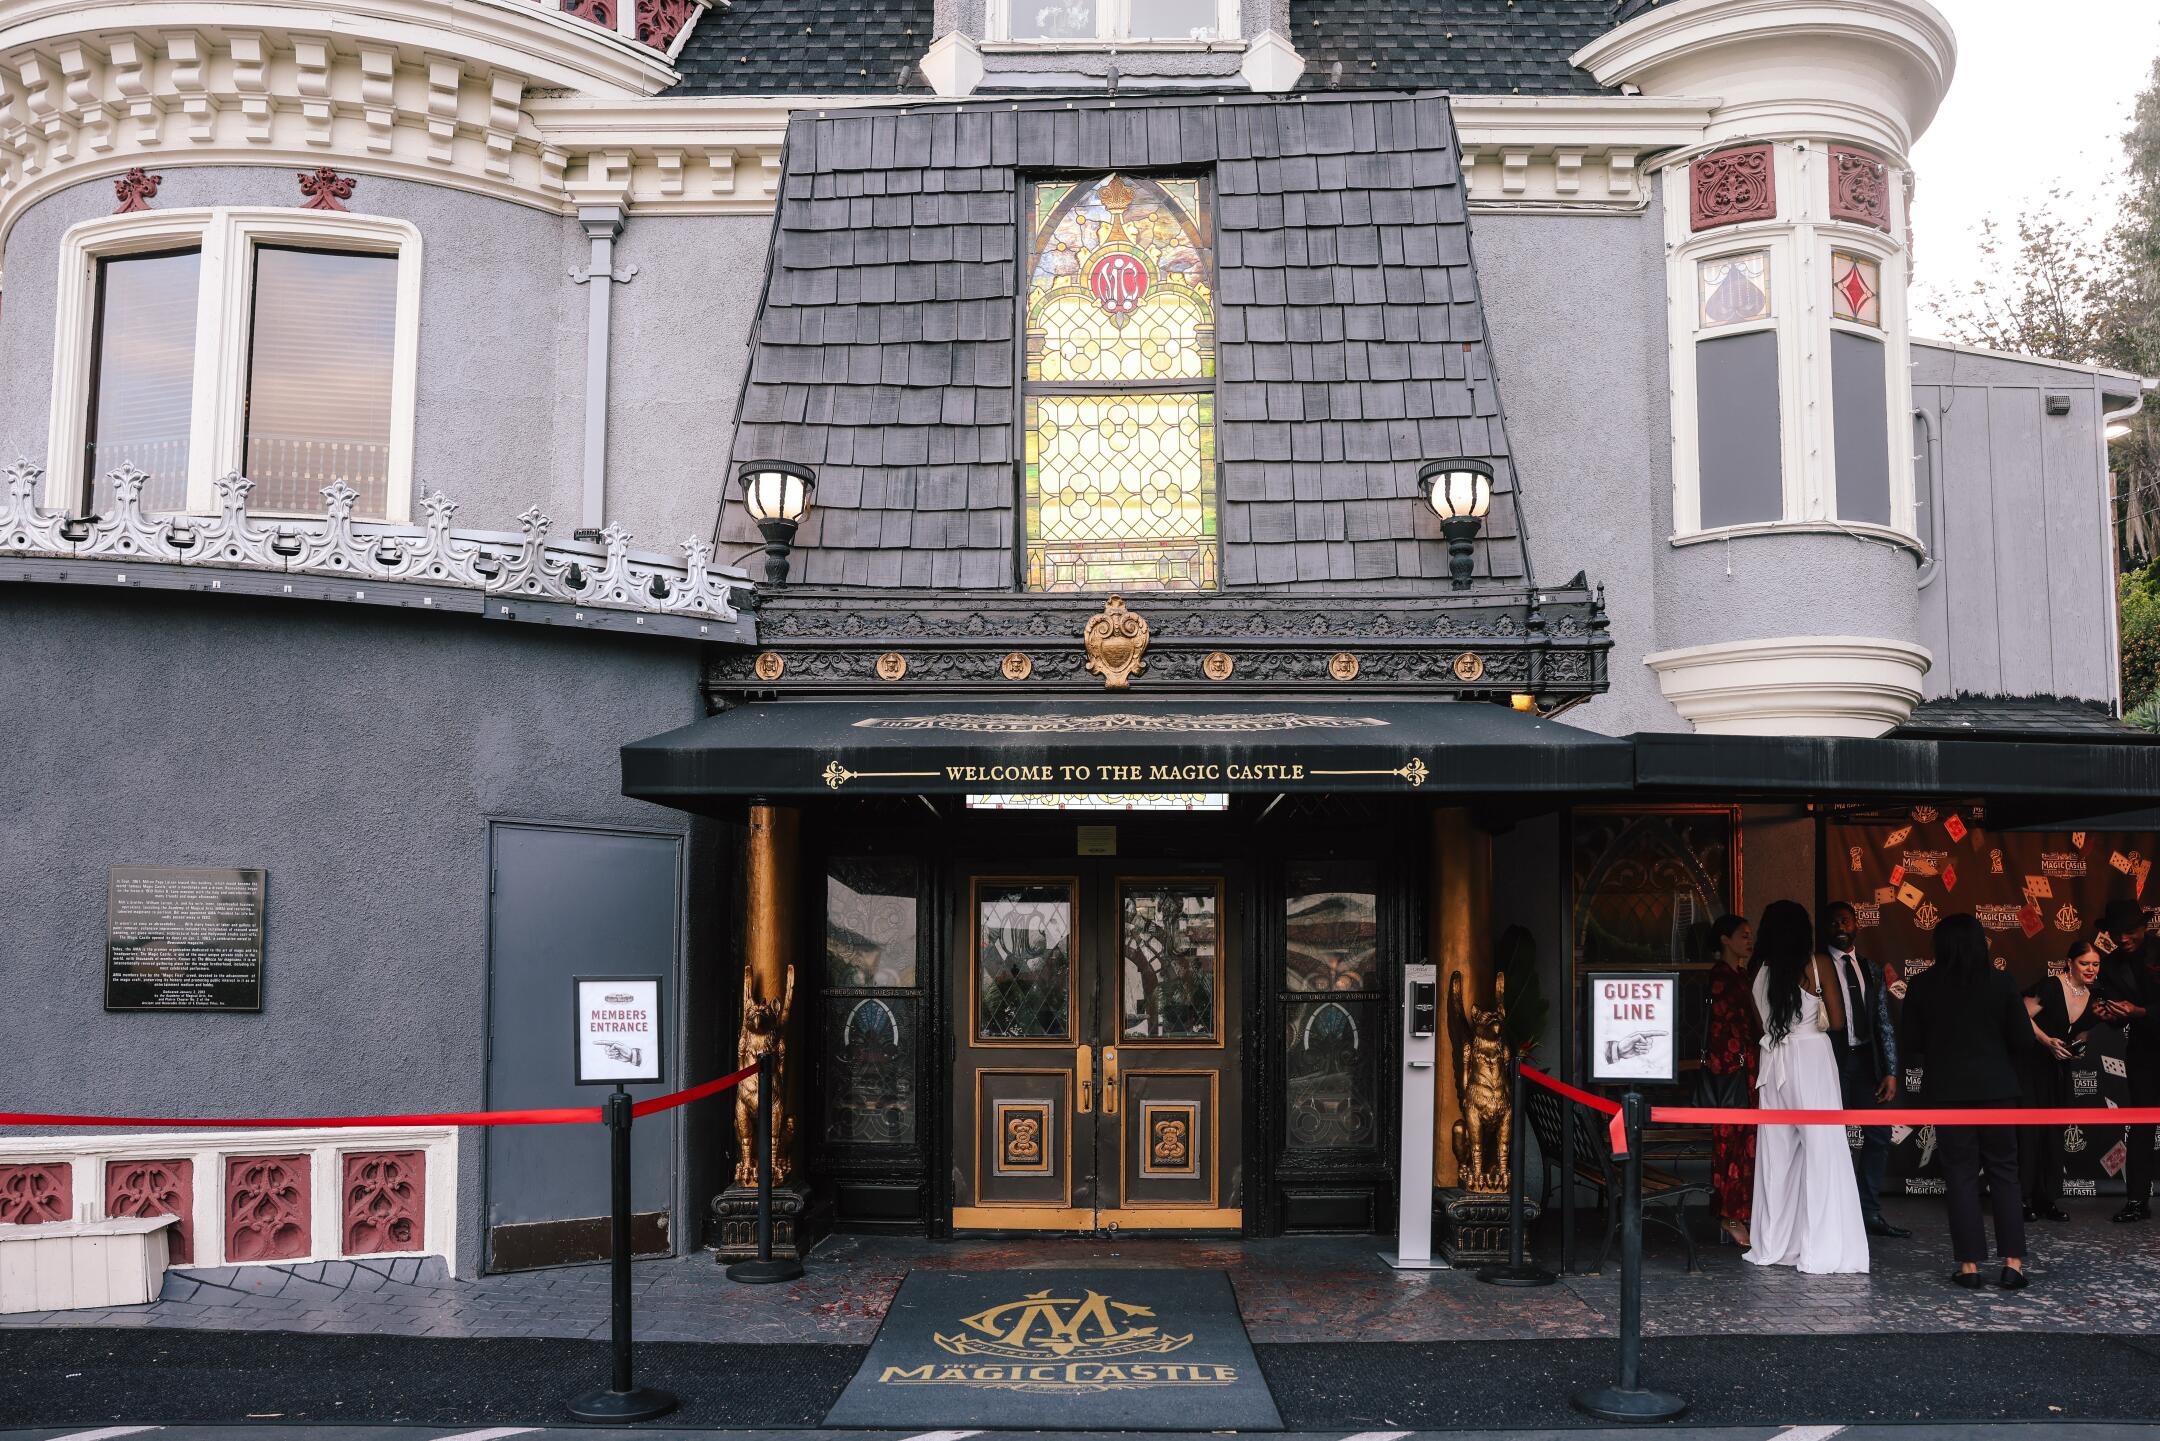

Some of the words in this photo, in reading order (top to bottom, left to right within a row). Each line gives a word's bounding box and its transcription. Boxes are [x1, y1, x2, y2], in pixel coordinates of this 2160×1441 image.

[945, 766, 1053, 781] WELCOME
[1060, 766, 1091, 781] TO
[1097, 766, 1143, 780] THE
[1149, 765, 1220, 780] MAGIC
[1226, 765, 1305, 780] CASTLE
[2042, 860, 2064, 870] MAGIC
[2065, 860, 2087, 870] CASTLE
[1858, 910, 1880, 920] CASTLE
[1975, 912, 1998, 921] MAGIC
[1998, 912, 2019, 922] CASTL
[1604, 983, 1664, 1000] GUEST
[591, 1010, 647, 1020] MEMBERS
[1613, 1004, 1655, 1020] LINE
[590, 1022, 649, 1033] ENTRANCE
[2074, 1079, 2098, 1089] CASTLE
[1905, 1186, 1929, 1195] MAGIC
[1929, 1186, 1945, 1195] CAST
[2072, 1188, 2097, 1196] CASTLE
[878, 1364, 1057, 1383] MAGIC
[1065, 1362, 1239, 1384] CASTLE
